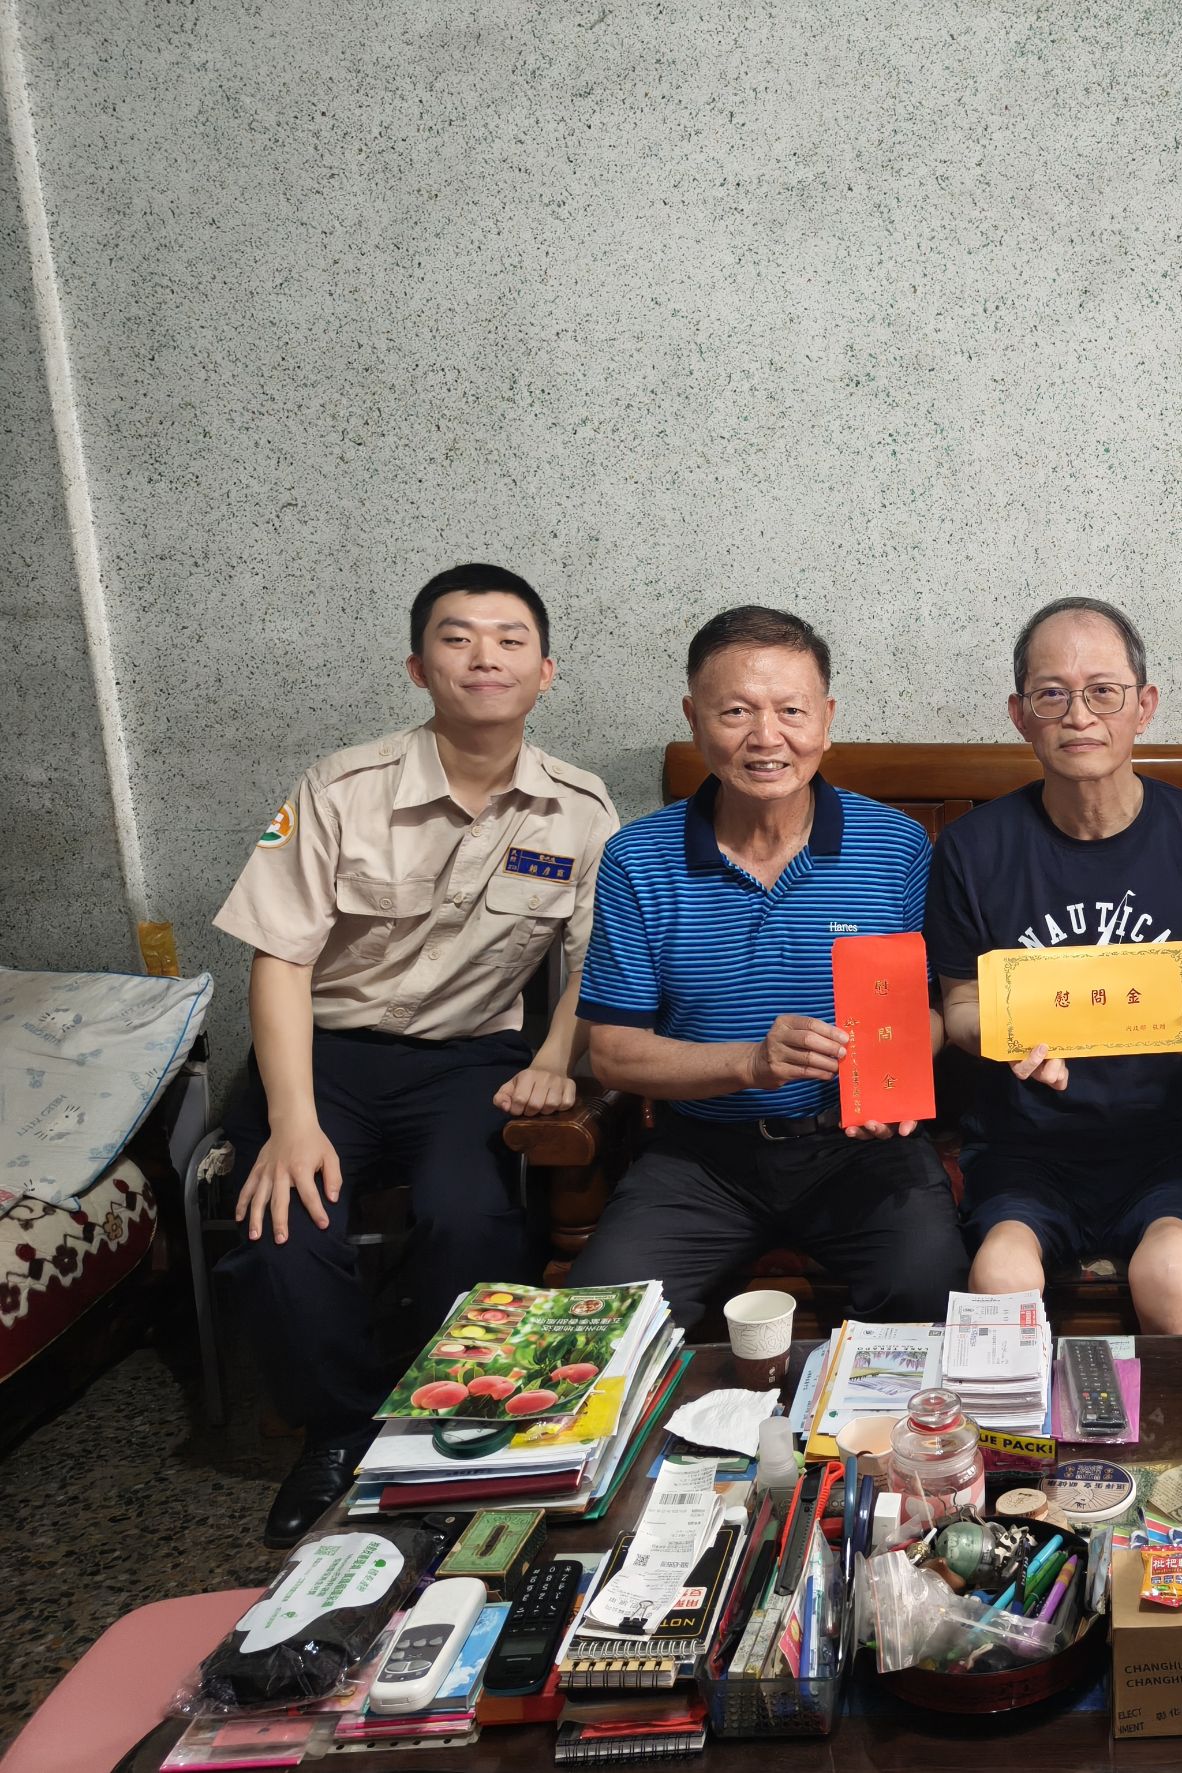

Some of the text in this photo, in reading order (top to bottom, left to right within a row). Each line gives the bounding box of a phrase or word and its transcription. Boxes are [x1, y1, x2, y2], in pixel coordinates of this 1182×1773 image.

[830, 922, 858, 932] Hanes
[1054, 988, 1143, 1008] 慰問金
[1003, 1438, 1053, 1454] PACK!
